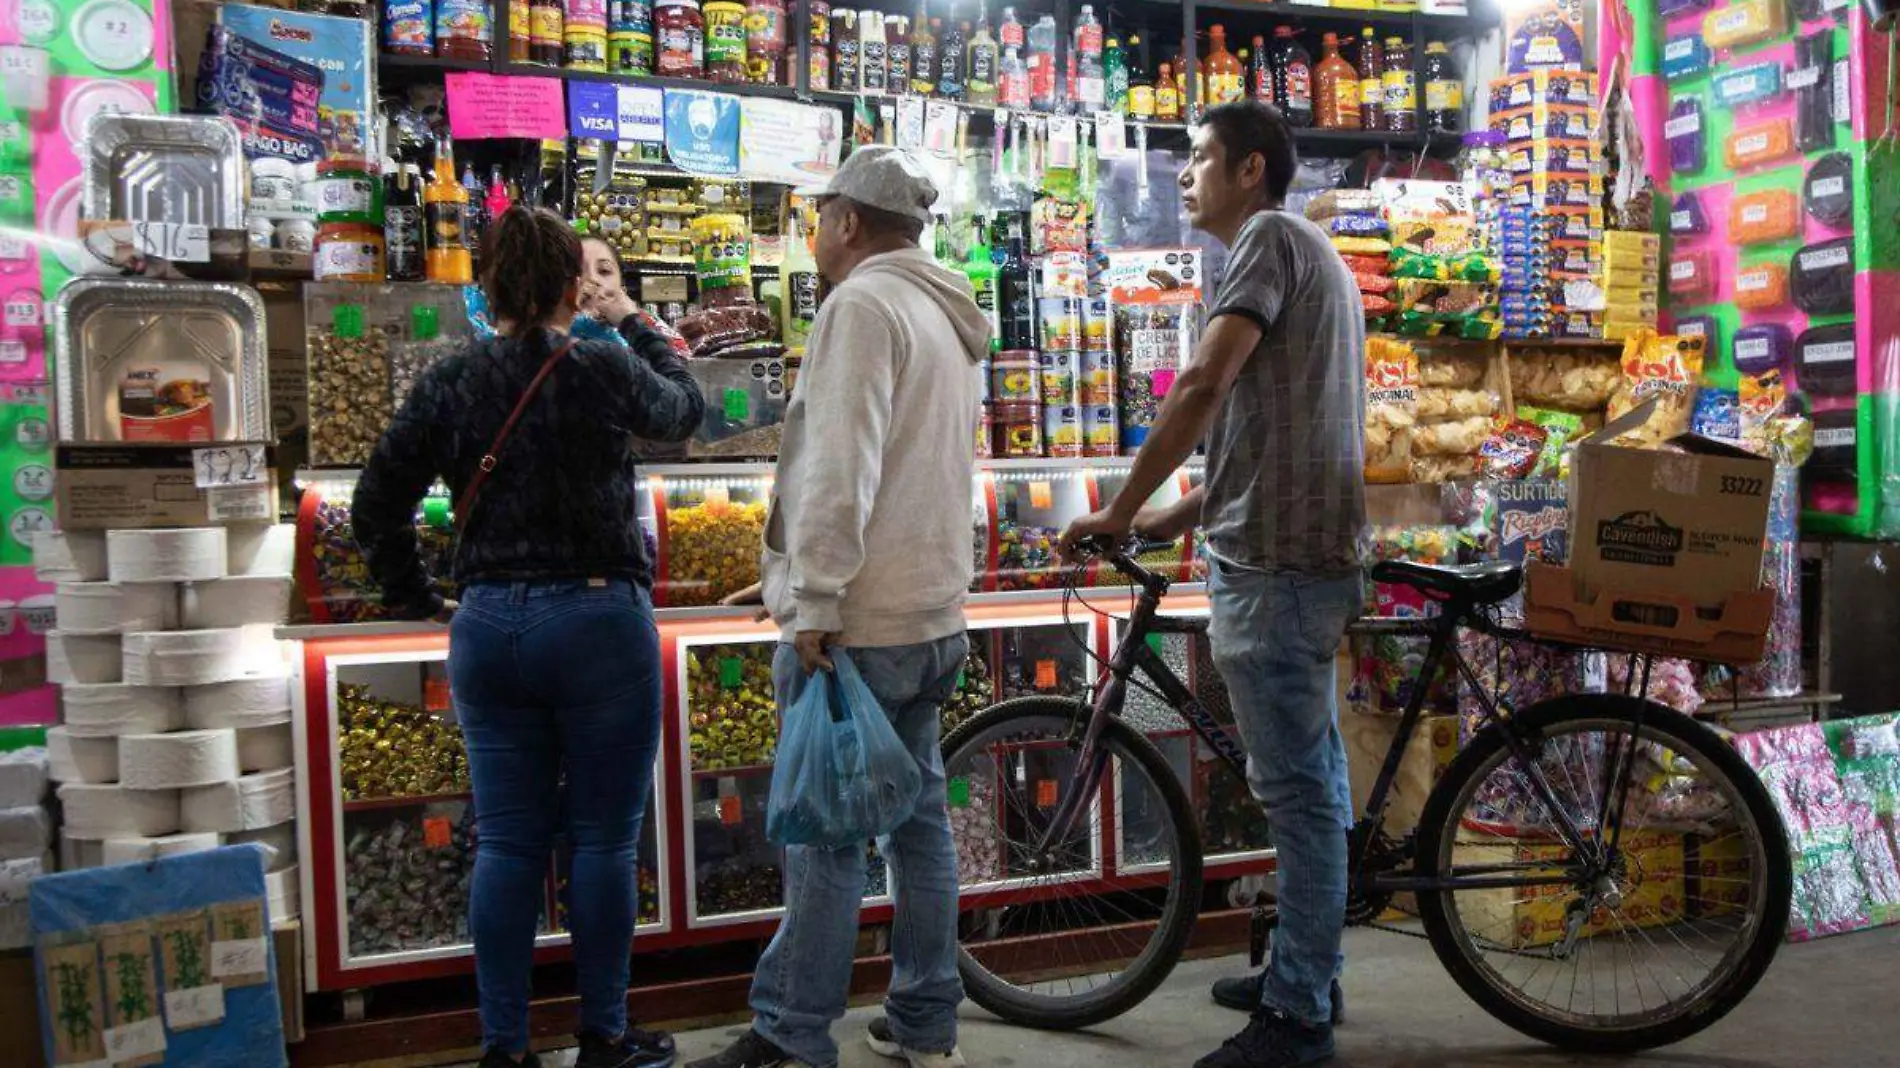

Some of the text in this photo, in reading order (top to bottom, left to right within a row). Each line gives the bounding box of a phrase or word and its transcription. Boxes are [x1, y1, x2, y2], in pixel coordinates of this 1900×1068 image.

[580, 116, 615, 131] VISA
[1719, 475, 1763, 497] 33222
[1601, 524, 1678, 549] Cavendish
